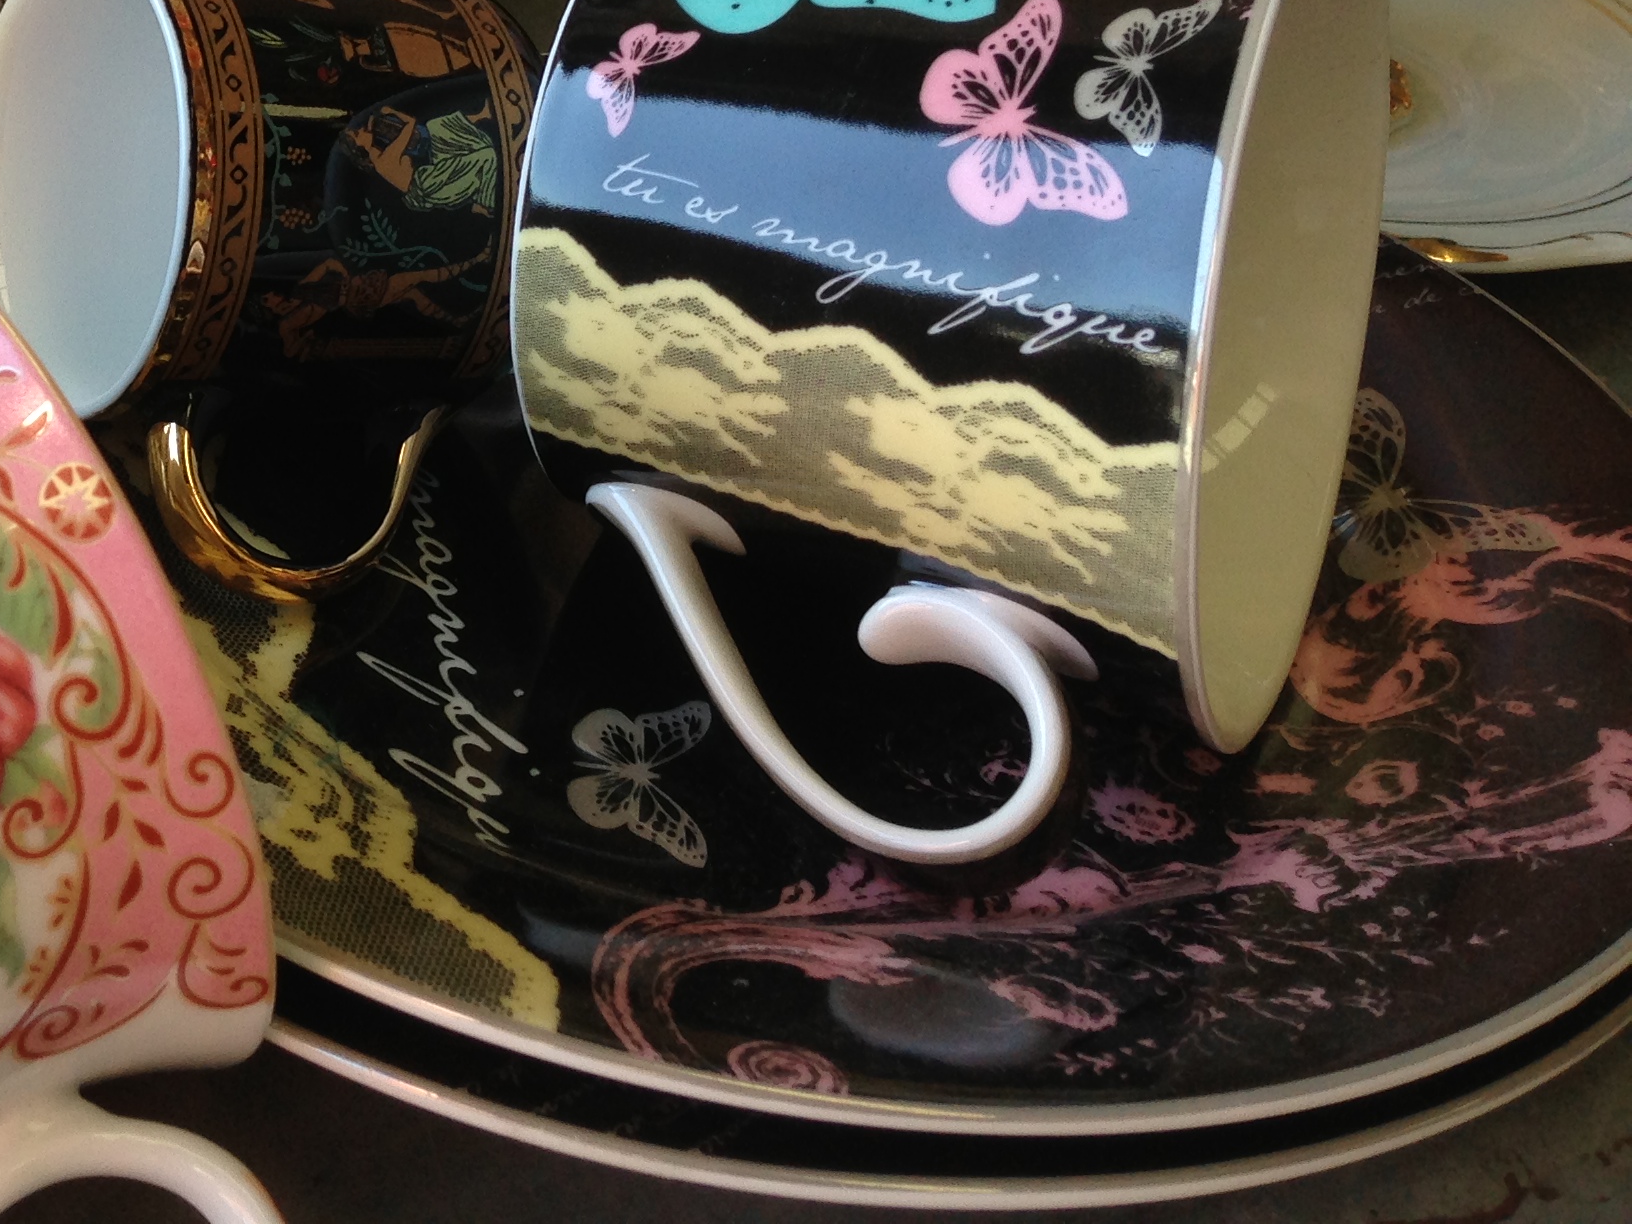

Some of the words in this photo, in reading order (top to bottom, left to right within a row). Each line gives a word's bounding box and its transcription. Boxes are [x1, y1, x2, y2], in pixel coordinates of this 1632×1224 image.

[601, 153, 696, 205] tu
[685, 191, 739, 225] es
[751, 215, 1167, 356] magnifique
[357, 466, 541, 864] magnifiqu
